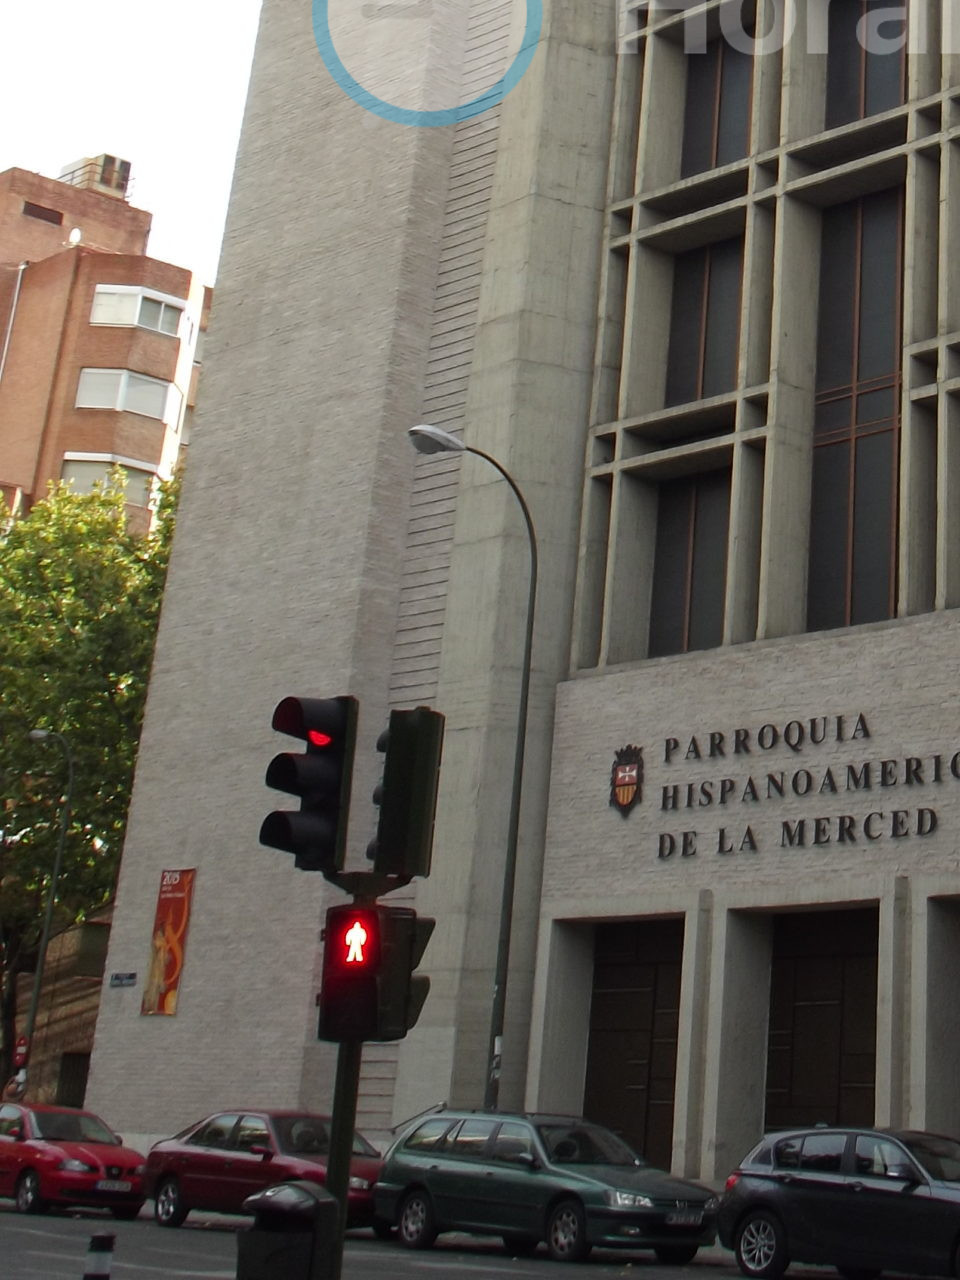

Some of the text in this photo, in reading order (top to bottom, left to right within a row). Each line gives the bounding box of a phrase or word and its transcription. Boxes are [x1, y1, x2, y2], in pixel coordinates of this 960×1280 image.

[663, 713, 872, 764] PARROQUIA
[657, 807, 939, 860] DE LA MERCED
